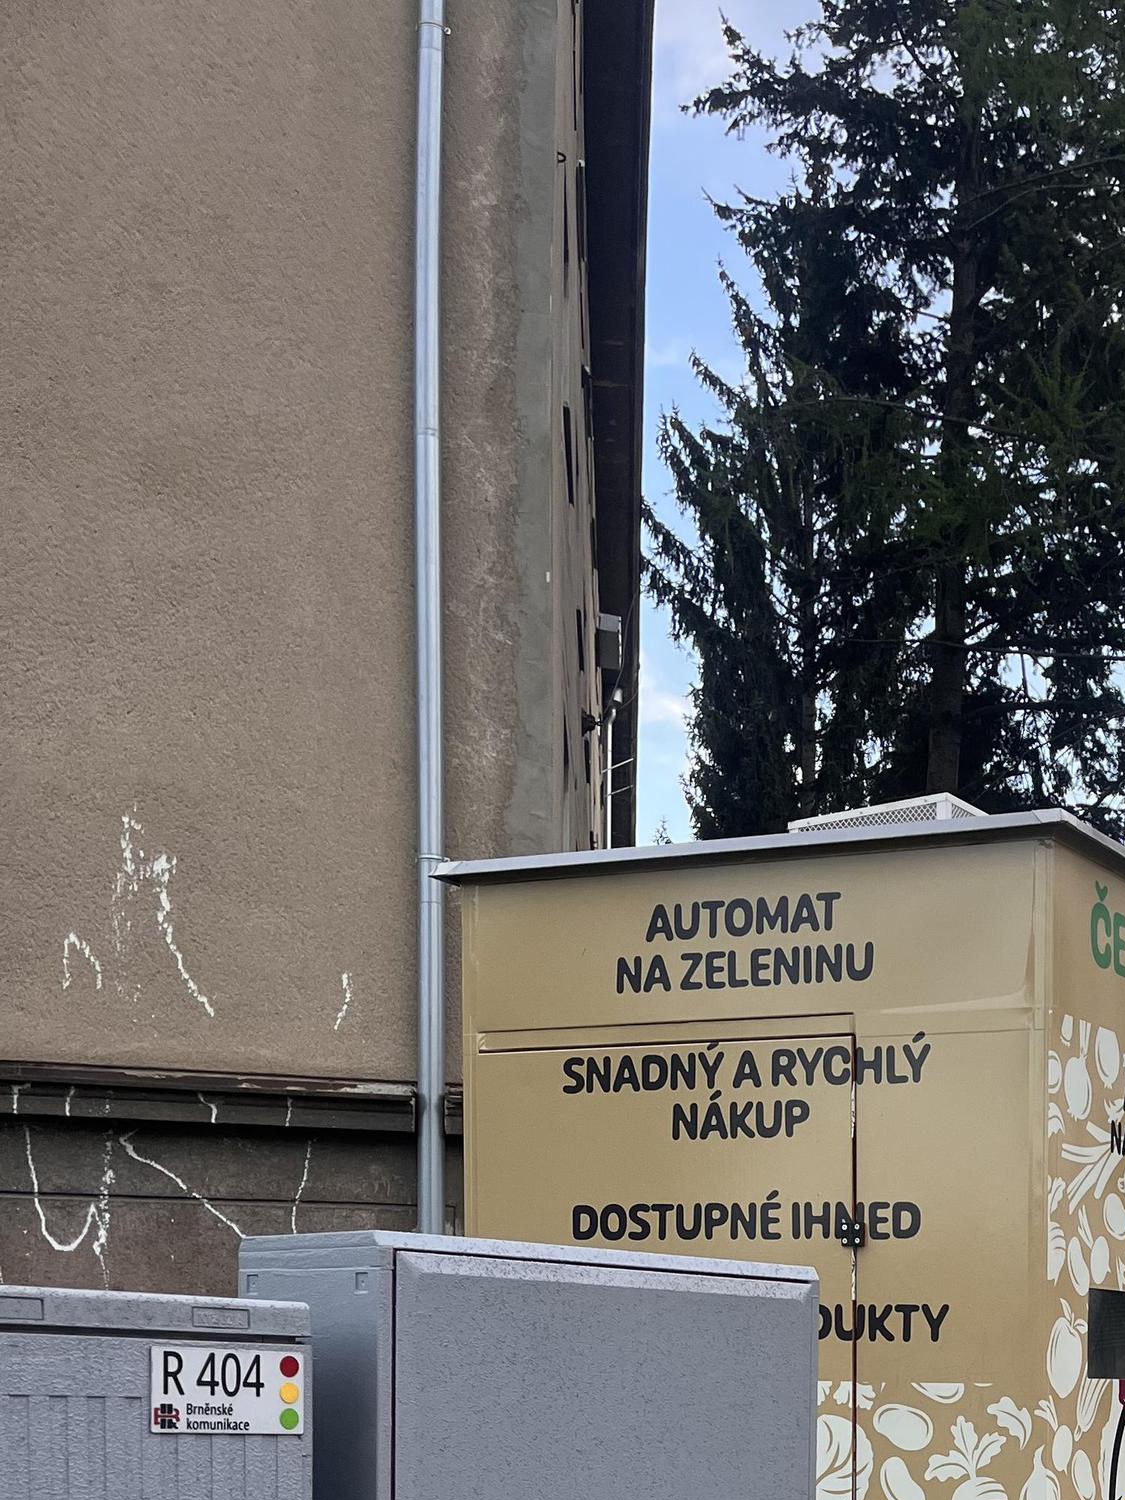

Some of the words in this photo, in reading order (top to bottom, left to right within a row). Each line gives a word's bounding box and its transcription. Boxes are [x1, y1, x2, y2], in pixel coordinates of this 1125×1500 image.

[645, 892, 841, 943] AUTOMAT
[616, 954, 671, 994] NA
[680, 941, 874, 991] ZELENINU
[562, 1041, 723, 1094] SNADNÝ
[733, 1049, 762, 1089] A
[772, 1031, 931, 1087] RYCHLÝ
[672, 1091, 810, 1140] NÁKUP
[573, 1190, 780, 1240] DOSTUPNÉ
[792, 1201, 922, 1240] IHNED
[163, 1350, 185, 1395] R
[196, 1352, 265, 1397] 404
[186, 1403, 234, 1416] Brněnské
[186, 1417, 250, 1431] komunikace
